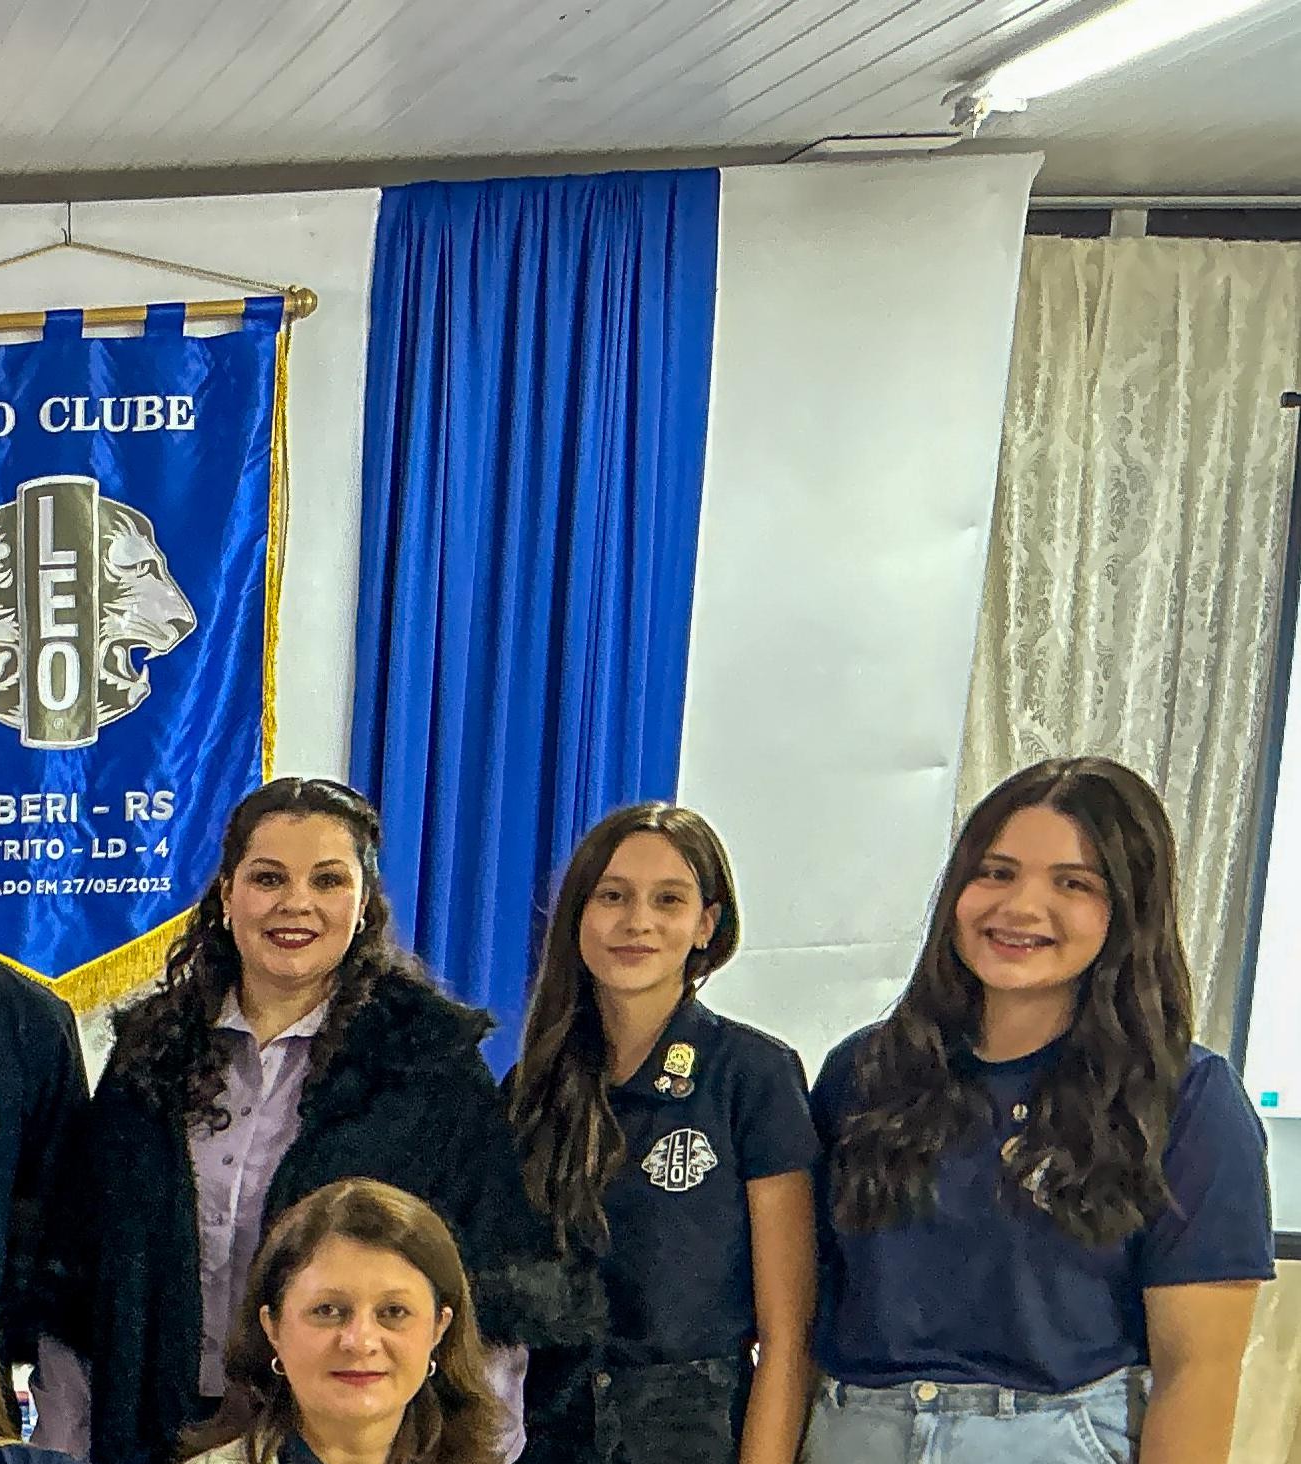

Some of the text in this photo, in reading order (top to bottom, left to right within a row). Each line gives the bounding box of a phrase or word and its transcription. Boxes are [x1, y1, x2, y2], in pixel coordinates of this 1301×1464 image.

[39, 395, 196, 434] CLUBE
[36, 495, 81, 711] LEO
[125, 791, 175, 822] RS
[92, 838, 127, 859] LD
[154, 836, 170, 859] 4
[36, 880, 58, 895] EM
[62, 877, 172, 895] 27/05/2023
[670, 1134, 685, 1183] LEO
